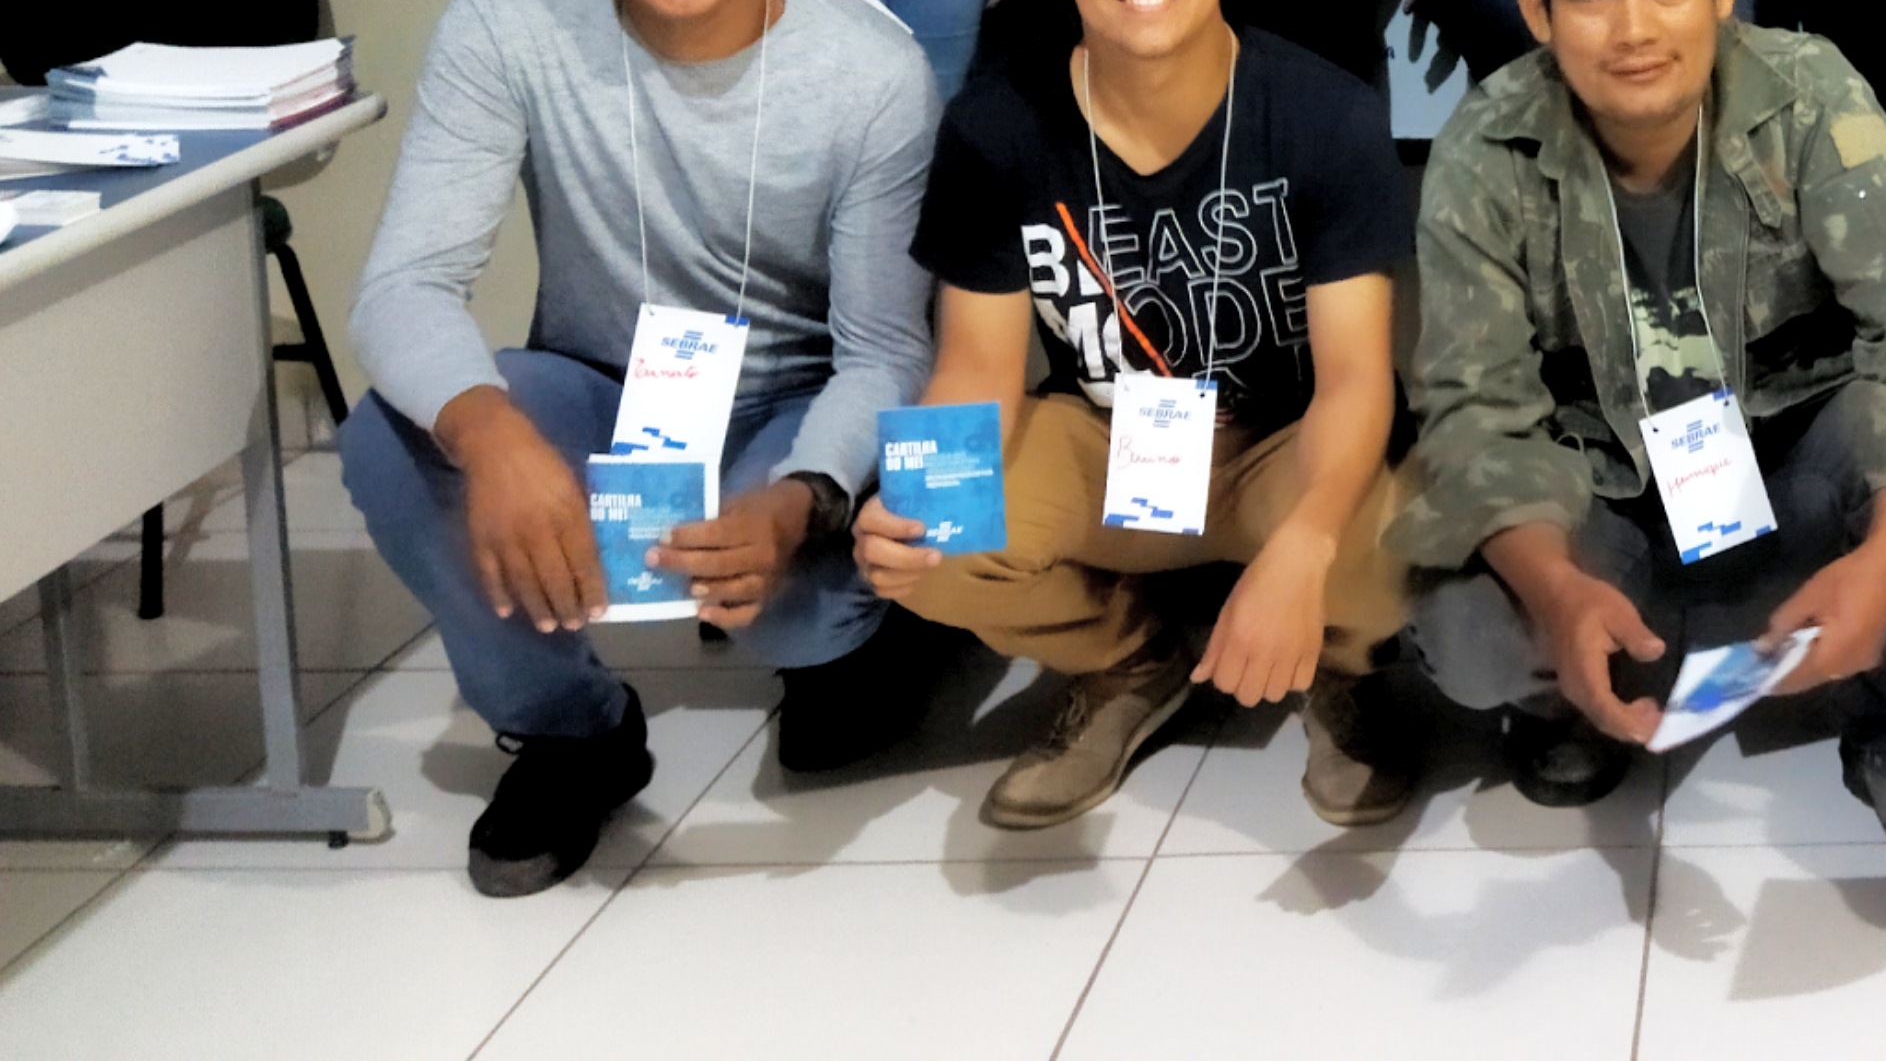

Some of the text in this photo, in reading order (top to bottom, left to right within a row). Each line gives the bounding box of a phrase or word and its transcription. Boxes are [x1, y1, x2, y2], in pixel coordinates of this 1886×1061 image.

[661, 337, 718, 354] SEBRAE
[1139, 407, 1191, 420] SEBRAE
[1671, 423, 1721, 450] SEBRAE
[885, 440, 938, 457] CARTILHA
[590, 493, 642, 508] CARTILHA
